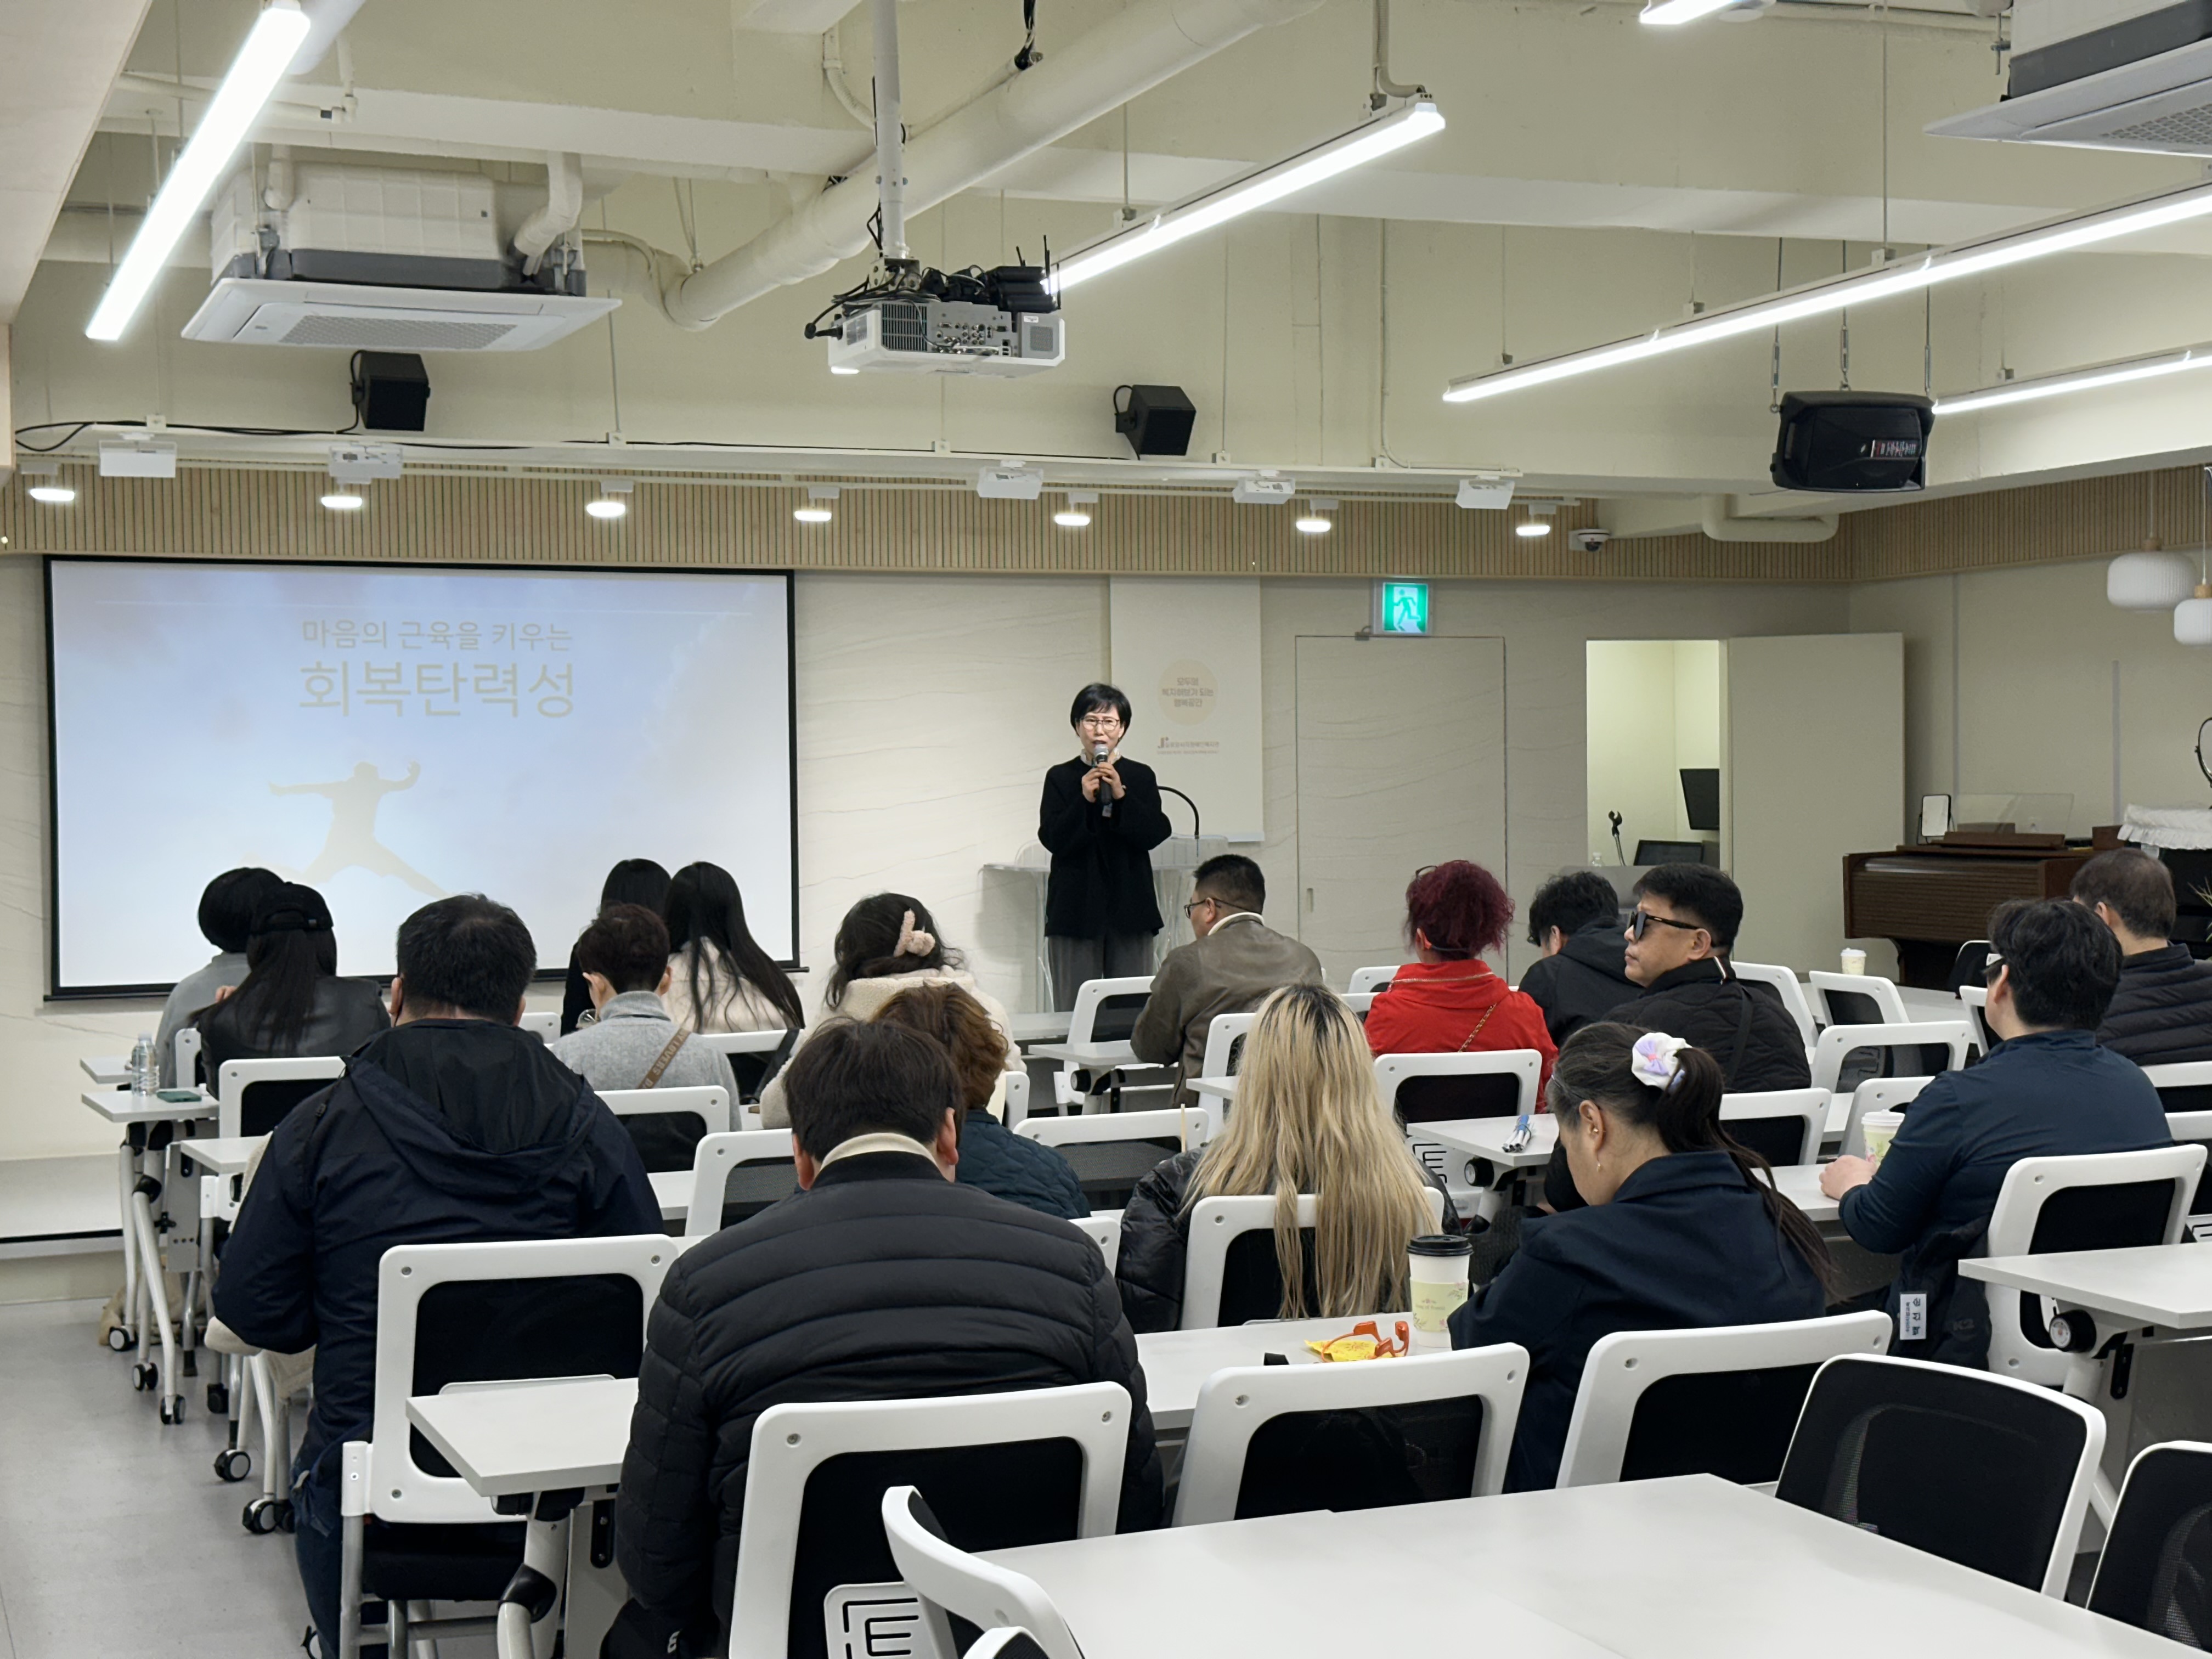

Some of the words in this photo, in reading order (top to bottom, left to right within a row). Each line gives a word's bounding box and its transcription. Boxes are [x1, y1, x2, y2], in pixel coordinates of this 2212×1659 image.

[302, 619, 387, 648] 마음의
[398, 621, 482, 650] 근육을
[492, 623, 572, 651] 키우는
[300, 661, 574, 718] 회복탄력성
[652, 1040, 680, 1076] LOVERS
